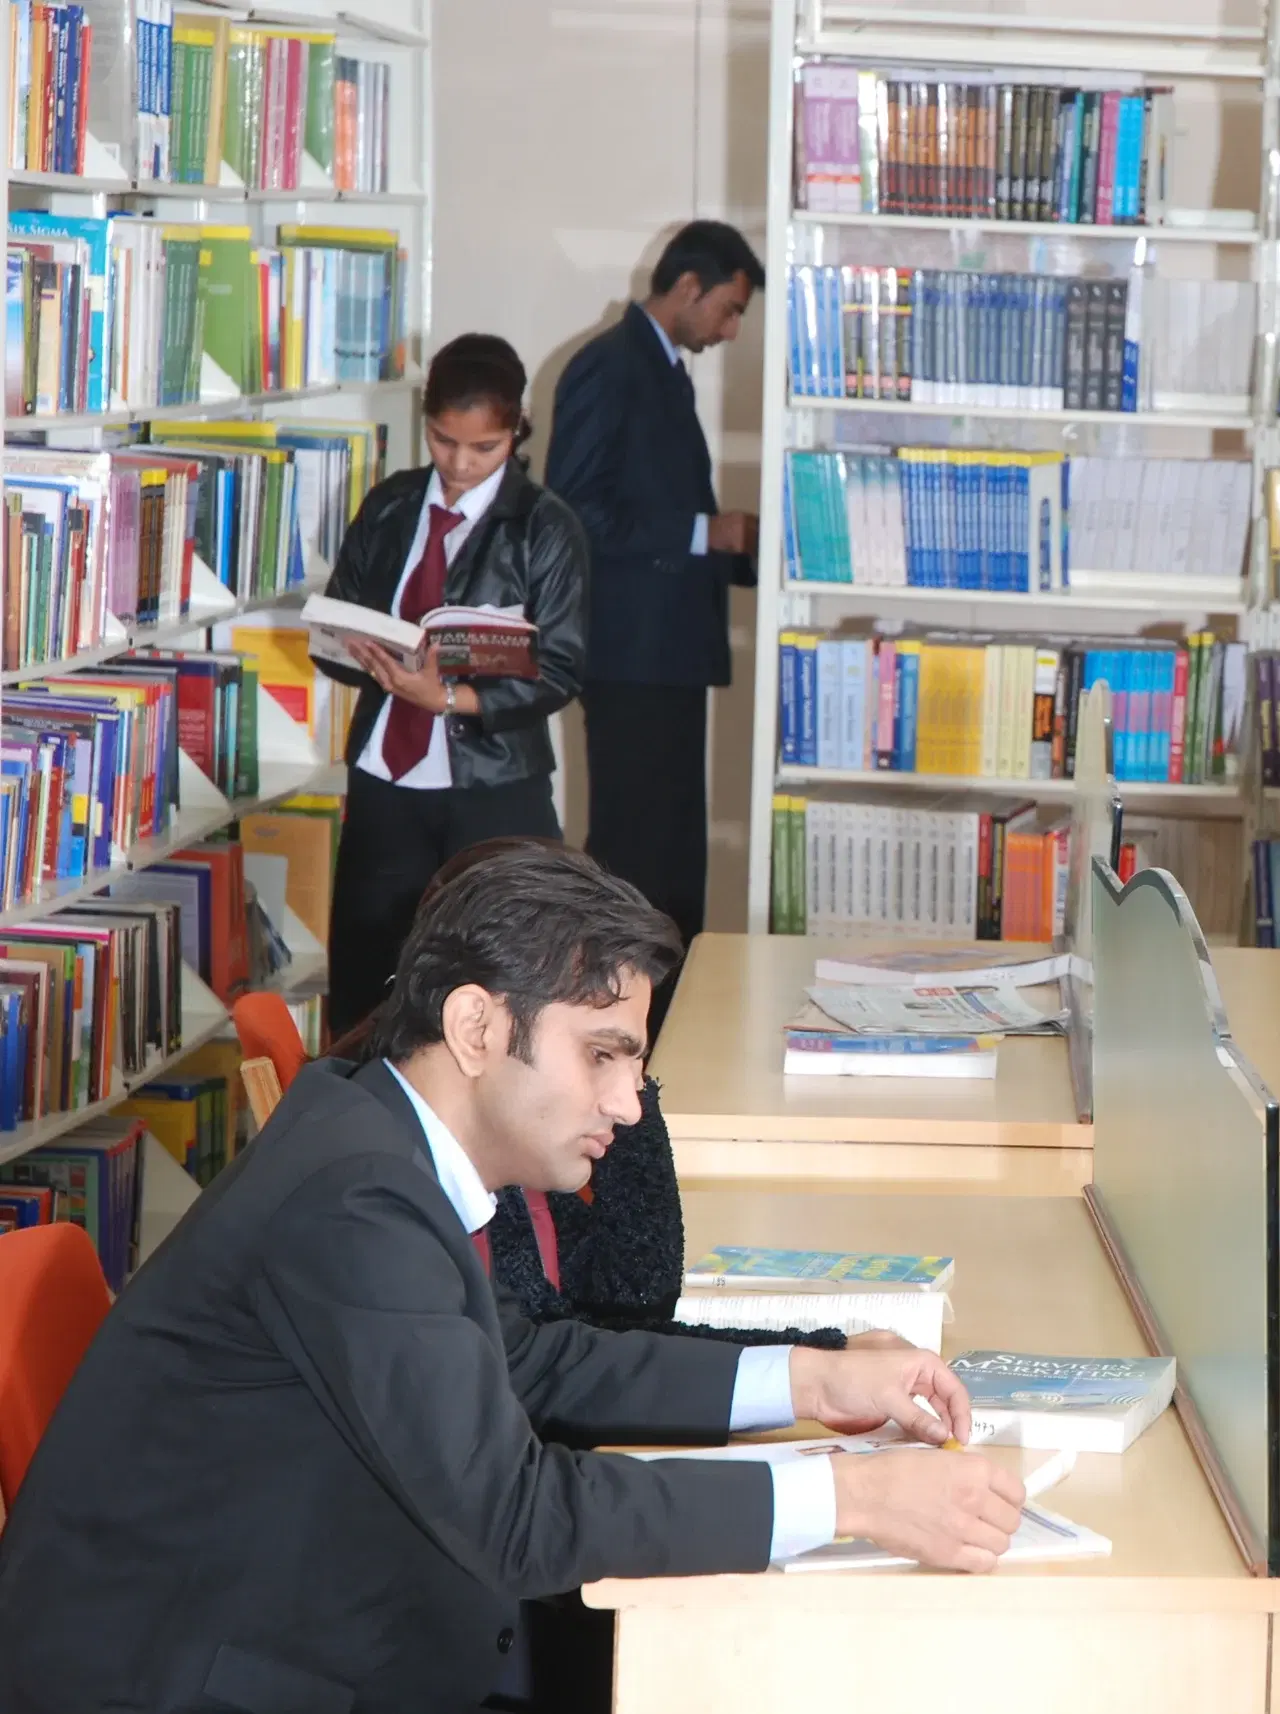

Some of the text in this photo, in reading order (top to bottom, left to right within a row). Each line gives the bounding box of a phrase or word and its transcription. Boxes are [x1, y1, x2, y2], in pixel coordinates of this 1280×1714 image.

[30, 224, 69, 237] SIGMA
[947, 1359, 1146, 1380] MARKETING
[992, 1354, 1134, 1371] SERVICES
